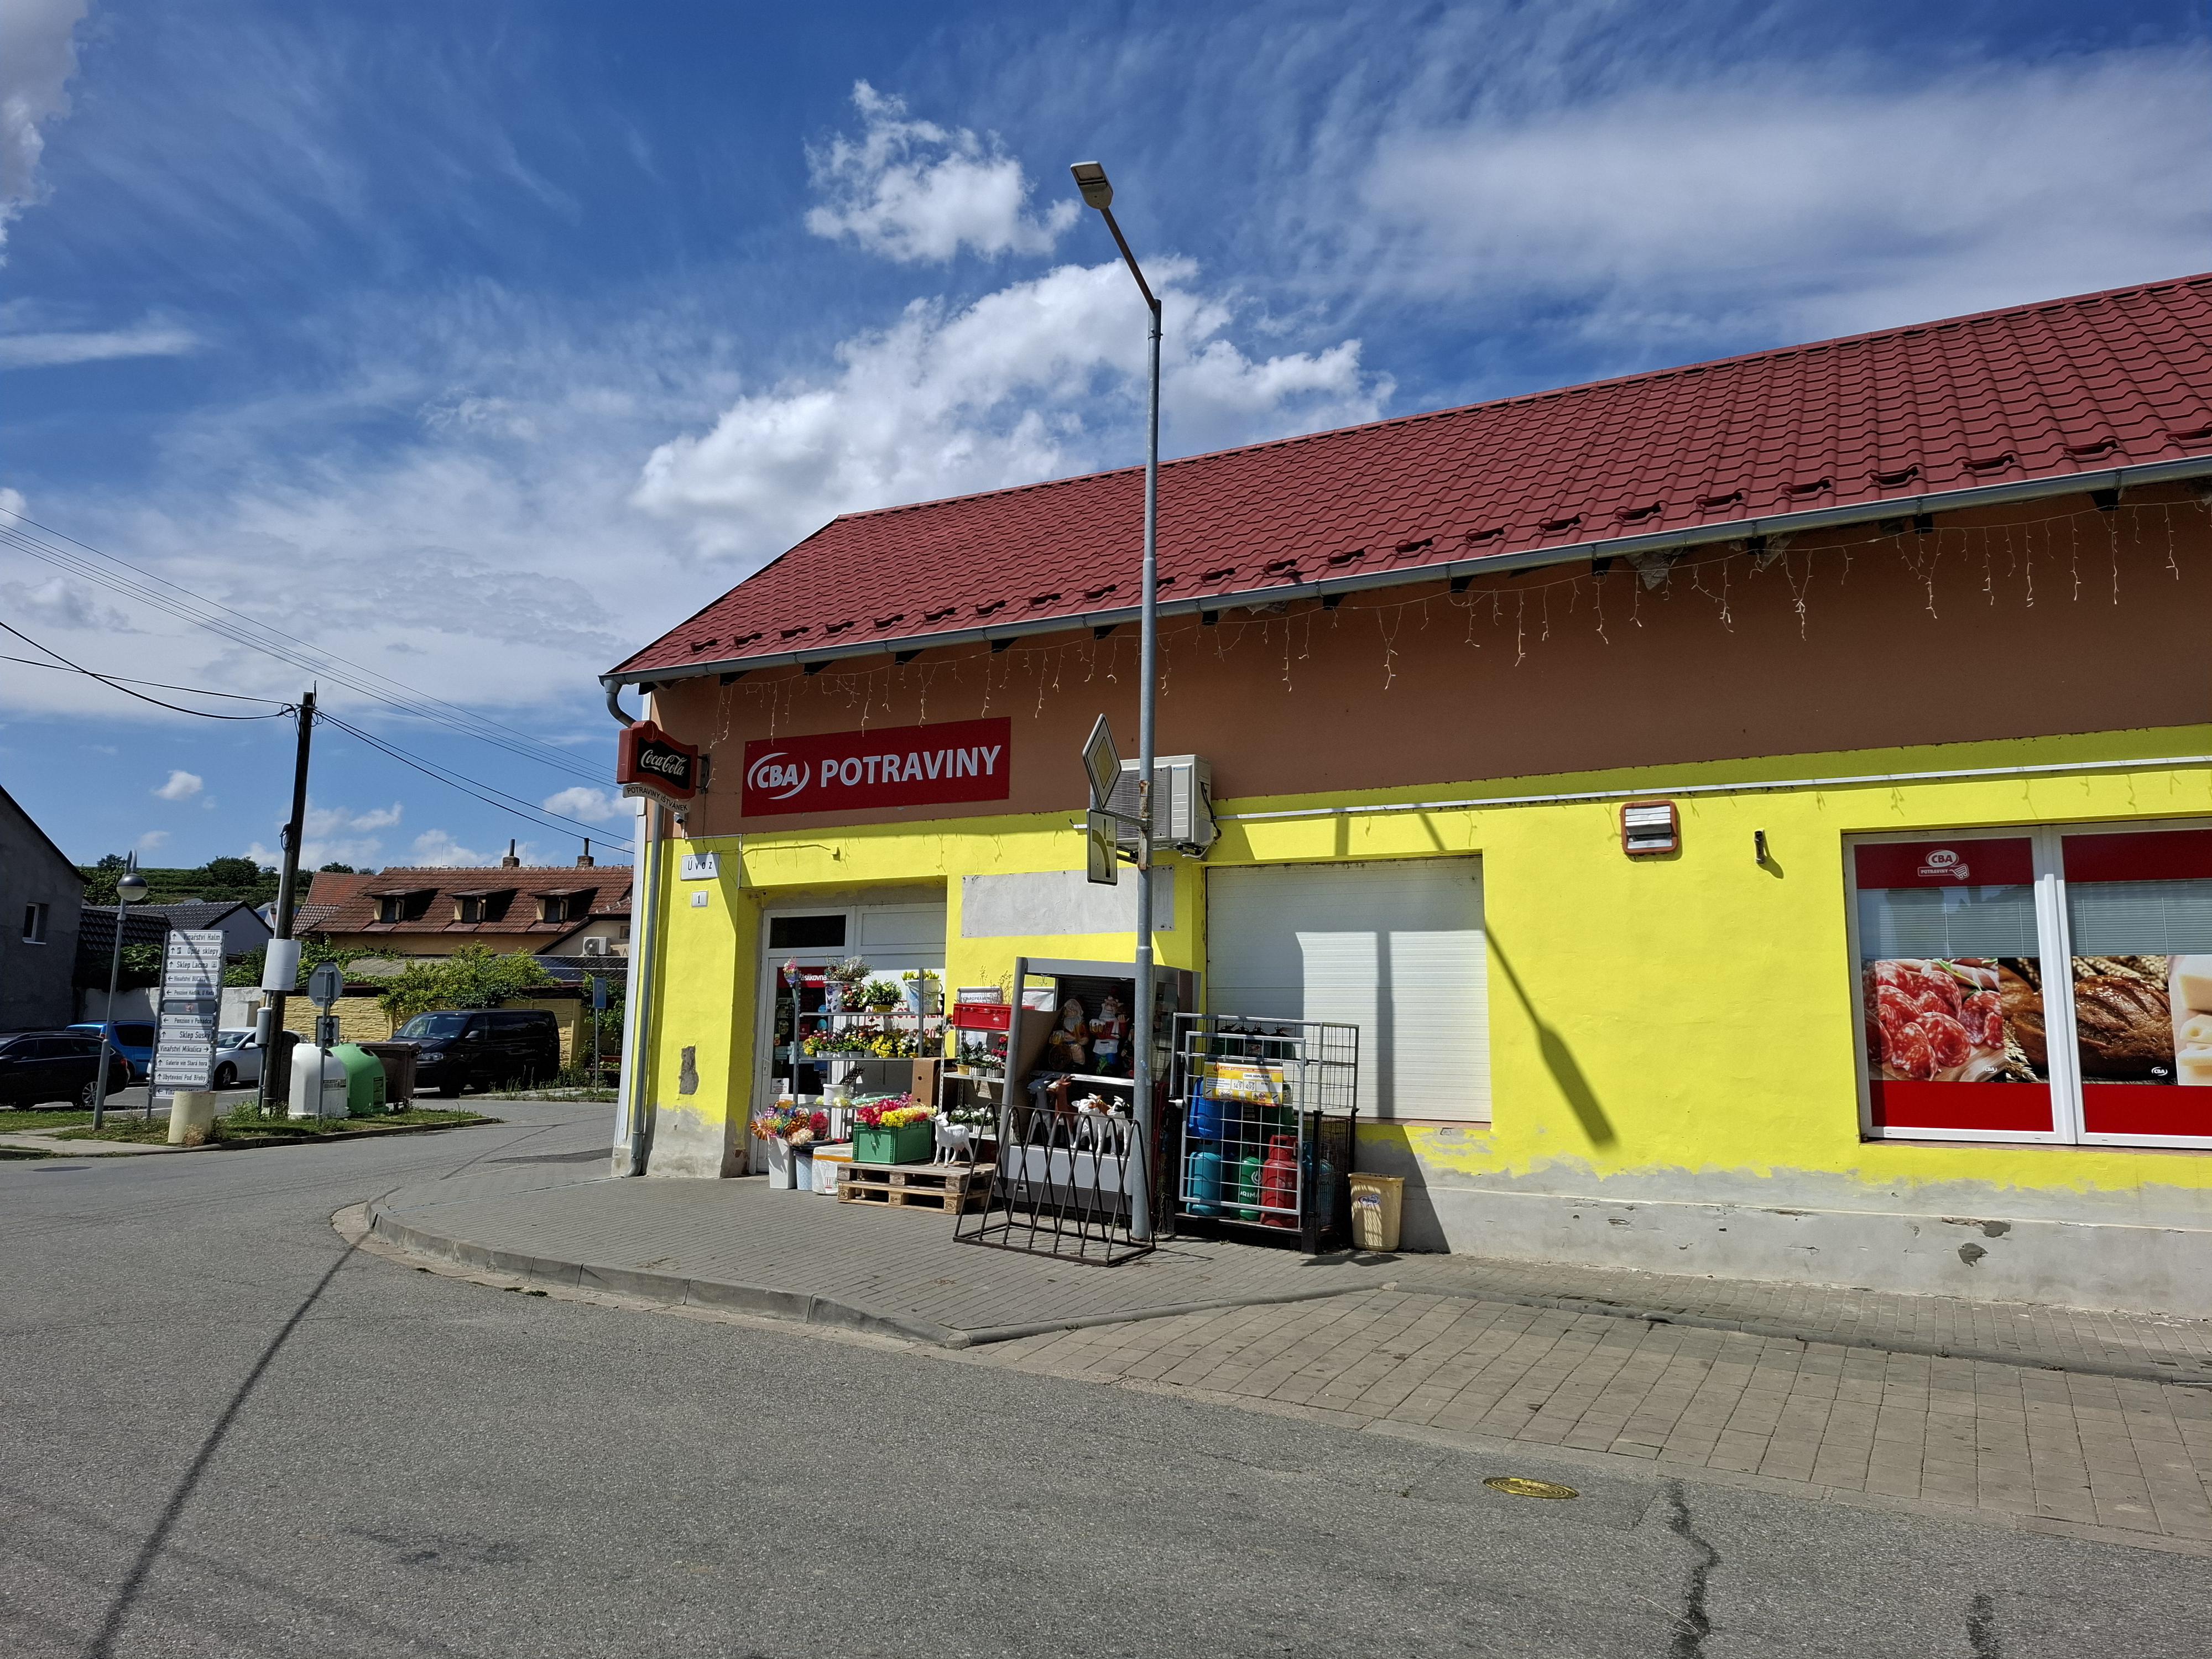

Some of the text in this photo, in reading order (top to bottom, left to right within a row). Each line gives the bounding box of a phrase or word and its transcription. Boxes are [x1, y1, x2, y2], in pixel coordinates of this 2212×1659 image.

[641, 749, 687, 775] Coca-Cola
[757, 745, 1001, 788] CBA POTRAVINY
[627, 786, 688, 811] POTRAVINY IŠTVÁNEK
[688, 857, 712, 870] Úvoz
[697, 895, 701, 904] 1
[187, 947, 218, 956] Opilé sklepy
[176, 961, 190, 969] Sklep
[179, 1031, 210, 1041] Sklep Suský
